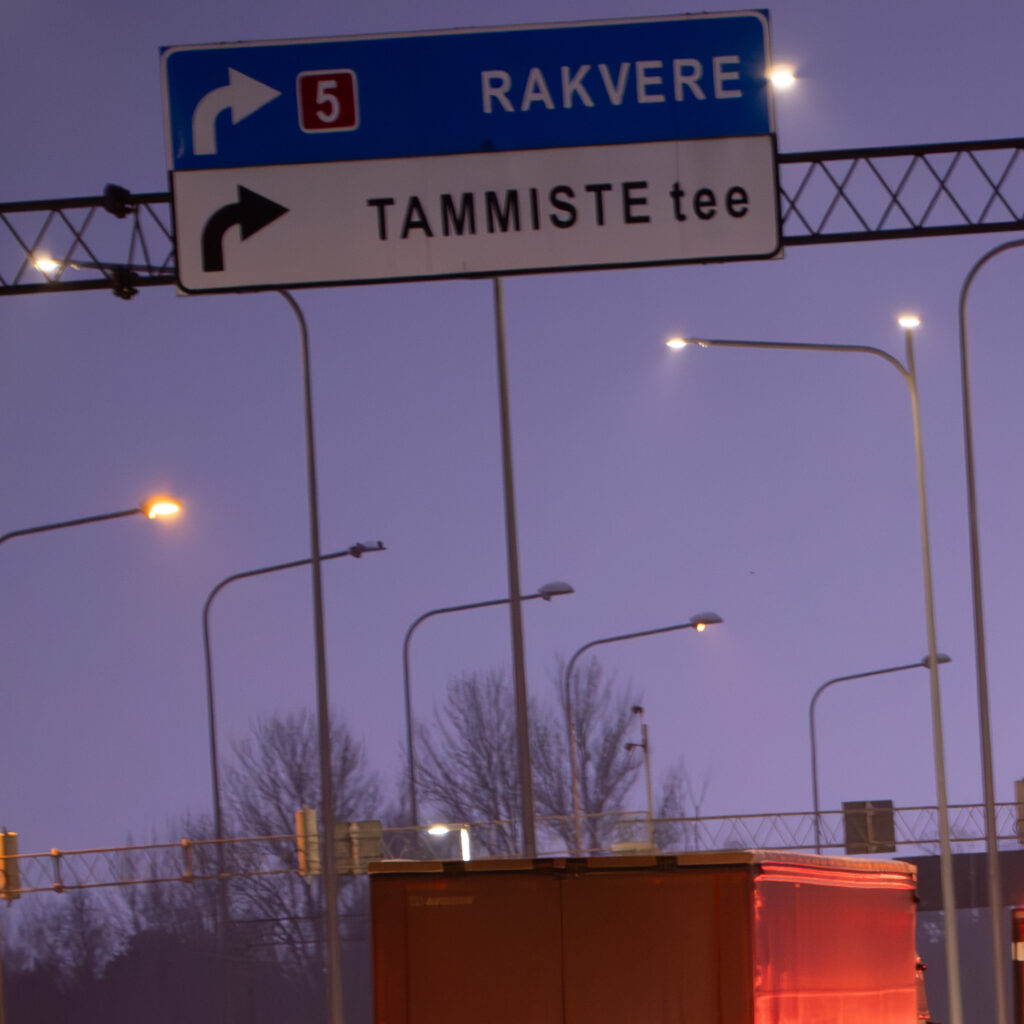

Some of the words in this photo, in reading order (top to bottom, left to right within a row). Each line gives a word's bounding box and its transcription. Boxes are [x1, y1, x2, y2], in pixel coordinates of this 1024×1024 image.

[316, 79, 340, 123] 5
[480, 54, 743, 115] RAKVERE
[367, 180, 651, 242] TAMMISTE
[670, 181, 750, 222] tee
